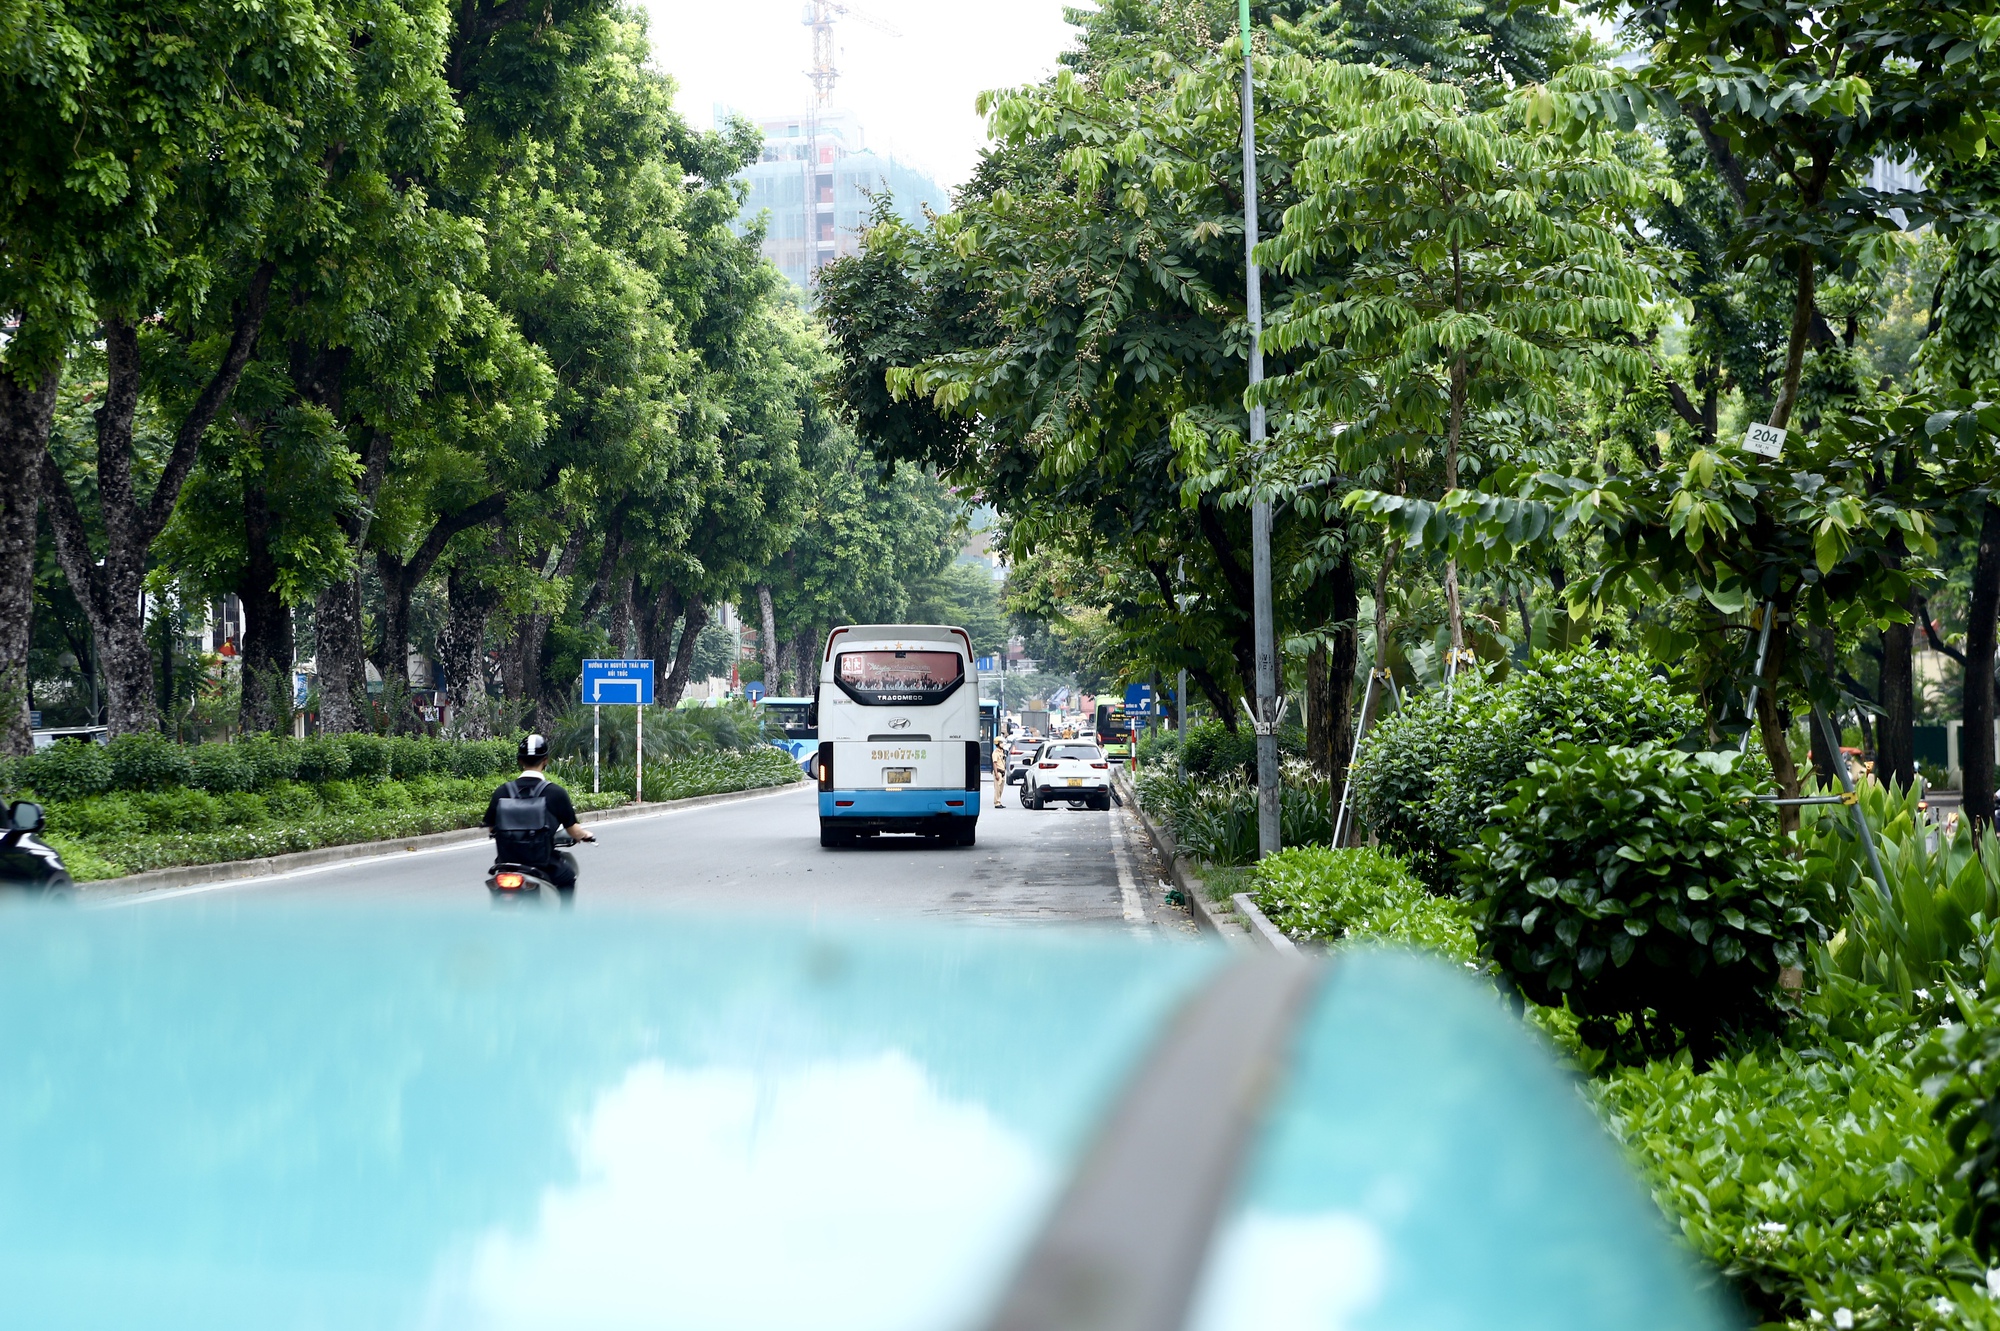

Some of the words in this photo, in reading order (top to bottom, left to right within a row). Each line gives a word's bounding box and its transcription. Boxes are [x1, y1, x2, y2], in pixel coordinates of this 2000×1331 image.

[1752, 429, 1778, 444] 204
[610, 660, 627, 668] NGUYỄN
[640, 662, 649, 670] HỌC
